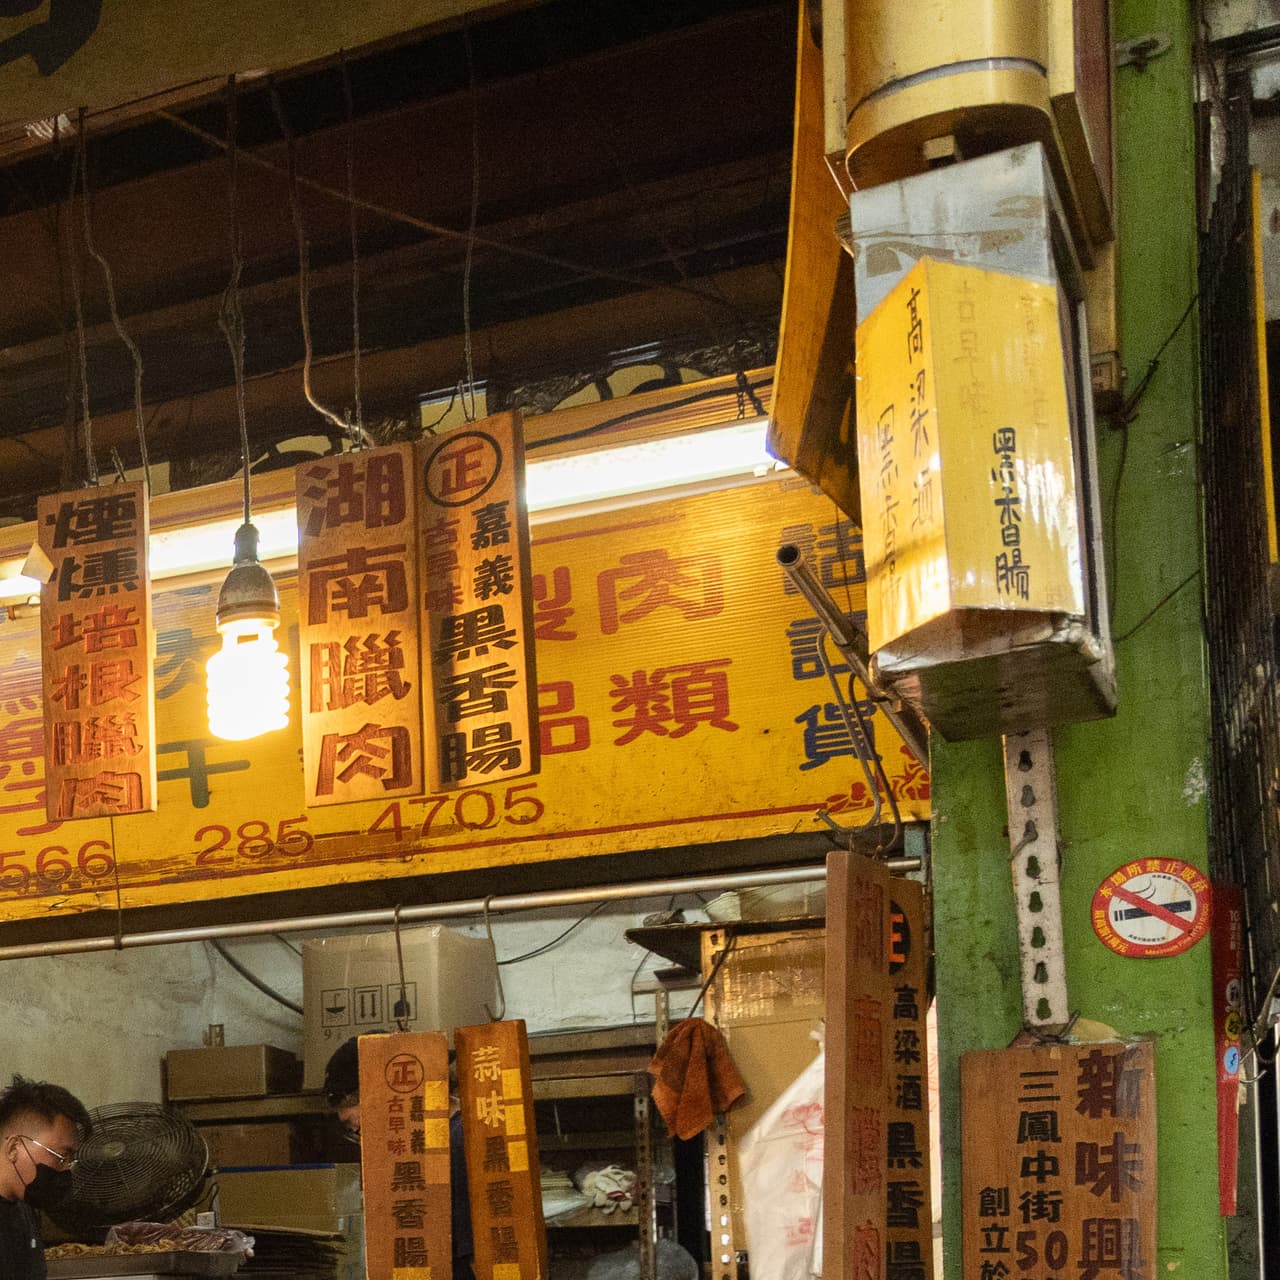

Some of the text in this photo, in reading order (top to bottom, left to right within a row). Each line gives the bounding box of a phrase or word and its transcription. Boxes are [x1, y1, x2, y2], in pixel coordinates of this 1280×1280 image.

[470, 499, 515, 602] 嘉義
[992, 427, 1030, 602] 黑香腸
[46, 491, 145, 818] 煙燻培根臘肉
[305, 452, 412, 798] 湖南臘肉
[432, 604, 522, 786] 黑香腸
[391, 1160, 429, 1269] 黑香腸
